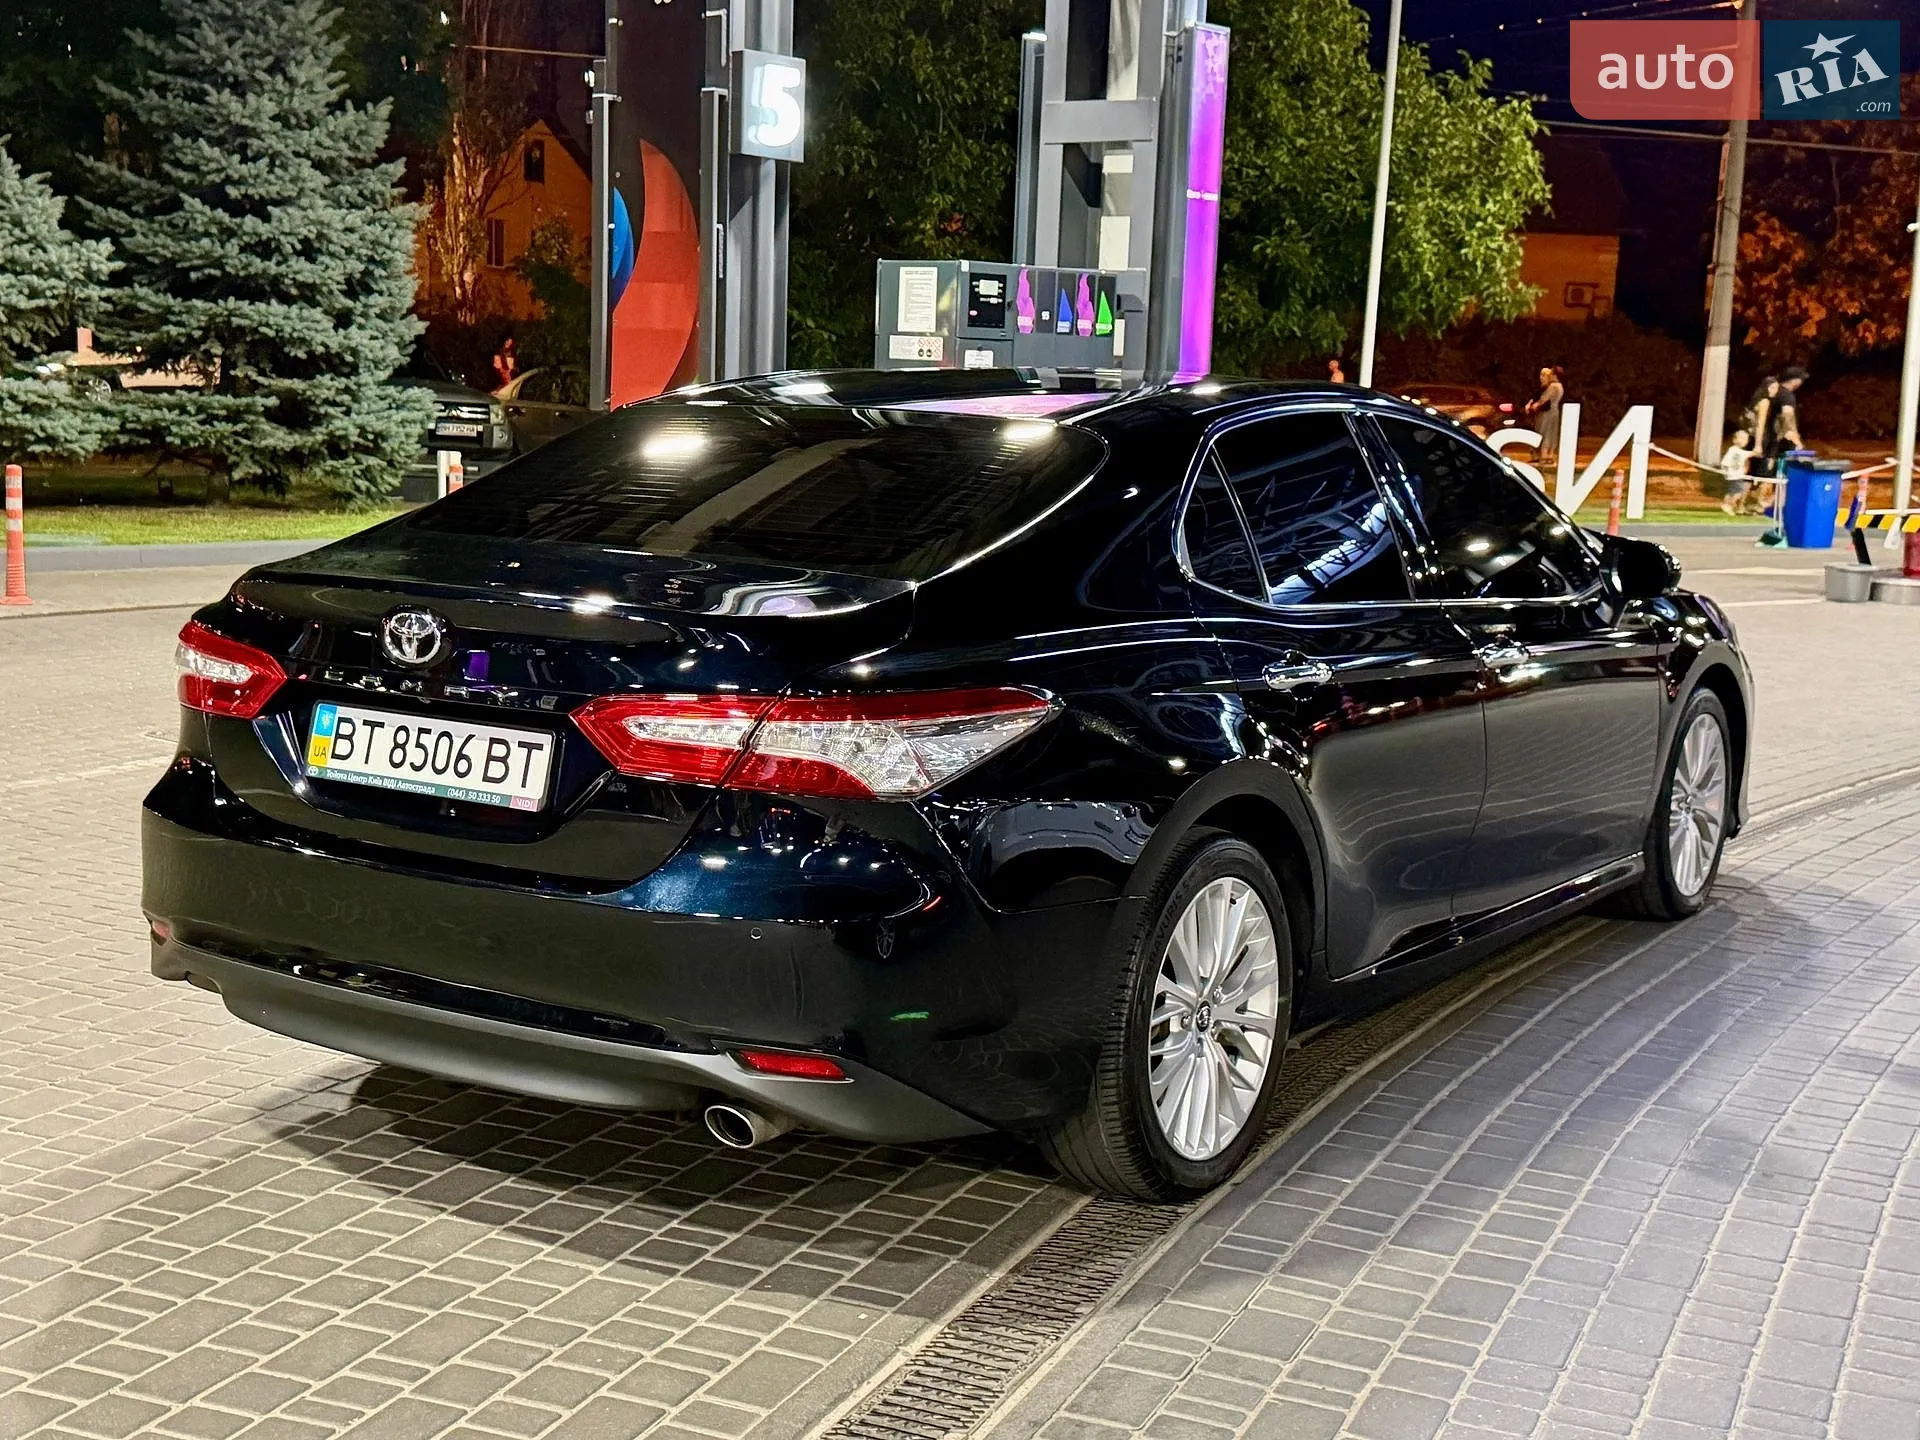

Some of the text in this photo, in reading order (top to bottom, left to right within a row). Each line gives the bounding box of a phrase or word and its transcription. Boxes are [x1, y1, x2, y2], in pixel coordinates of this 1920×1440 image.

[750, 63, 801, 147] 5
[313, 743, 327, 758] UA
[331, 717, 544, 788] BT 8506 BT
[447, 787, 466, 799] (044)
[468, 790, 477, 800] 50
[492, 794, 501, 804] 50
